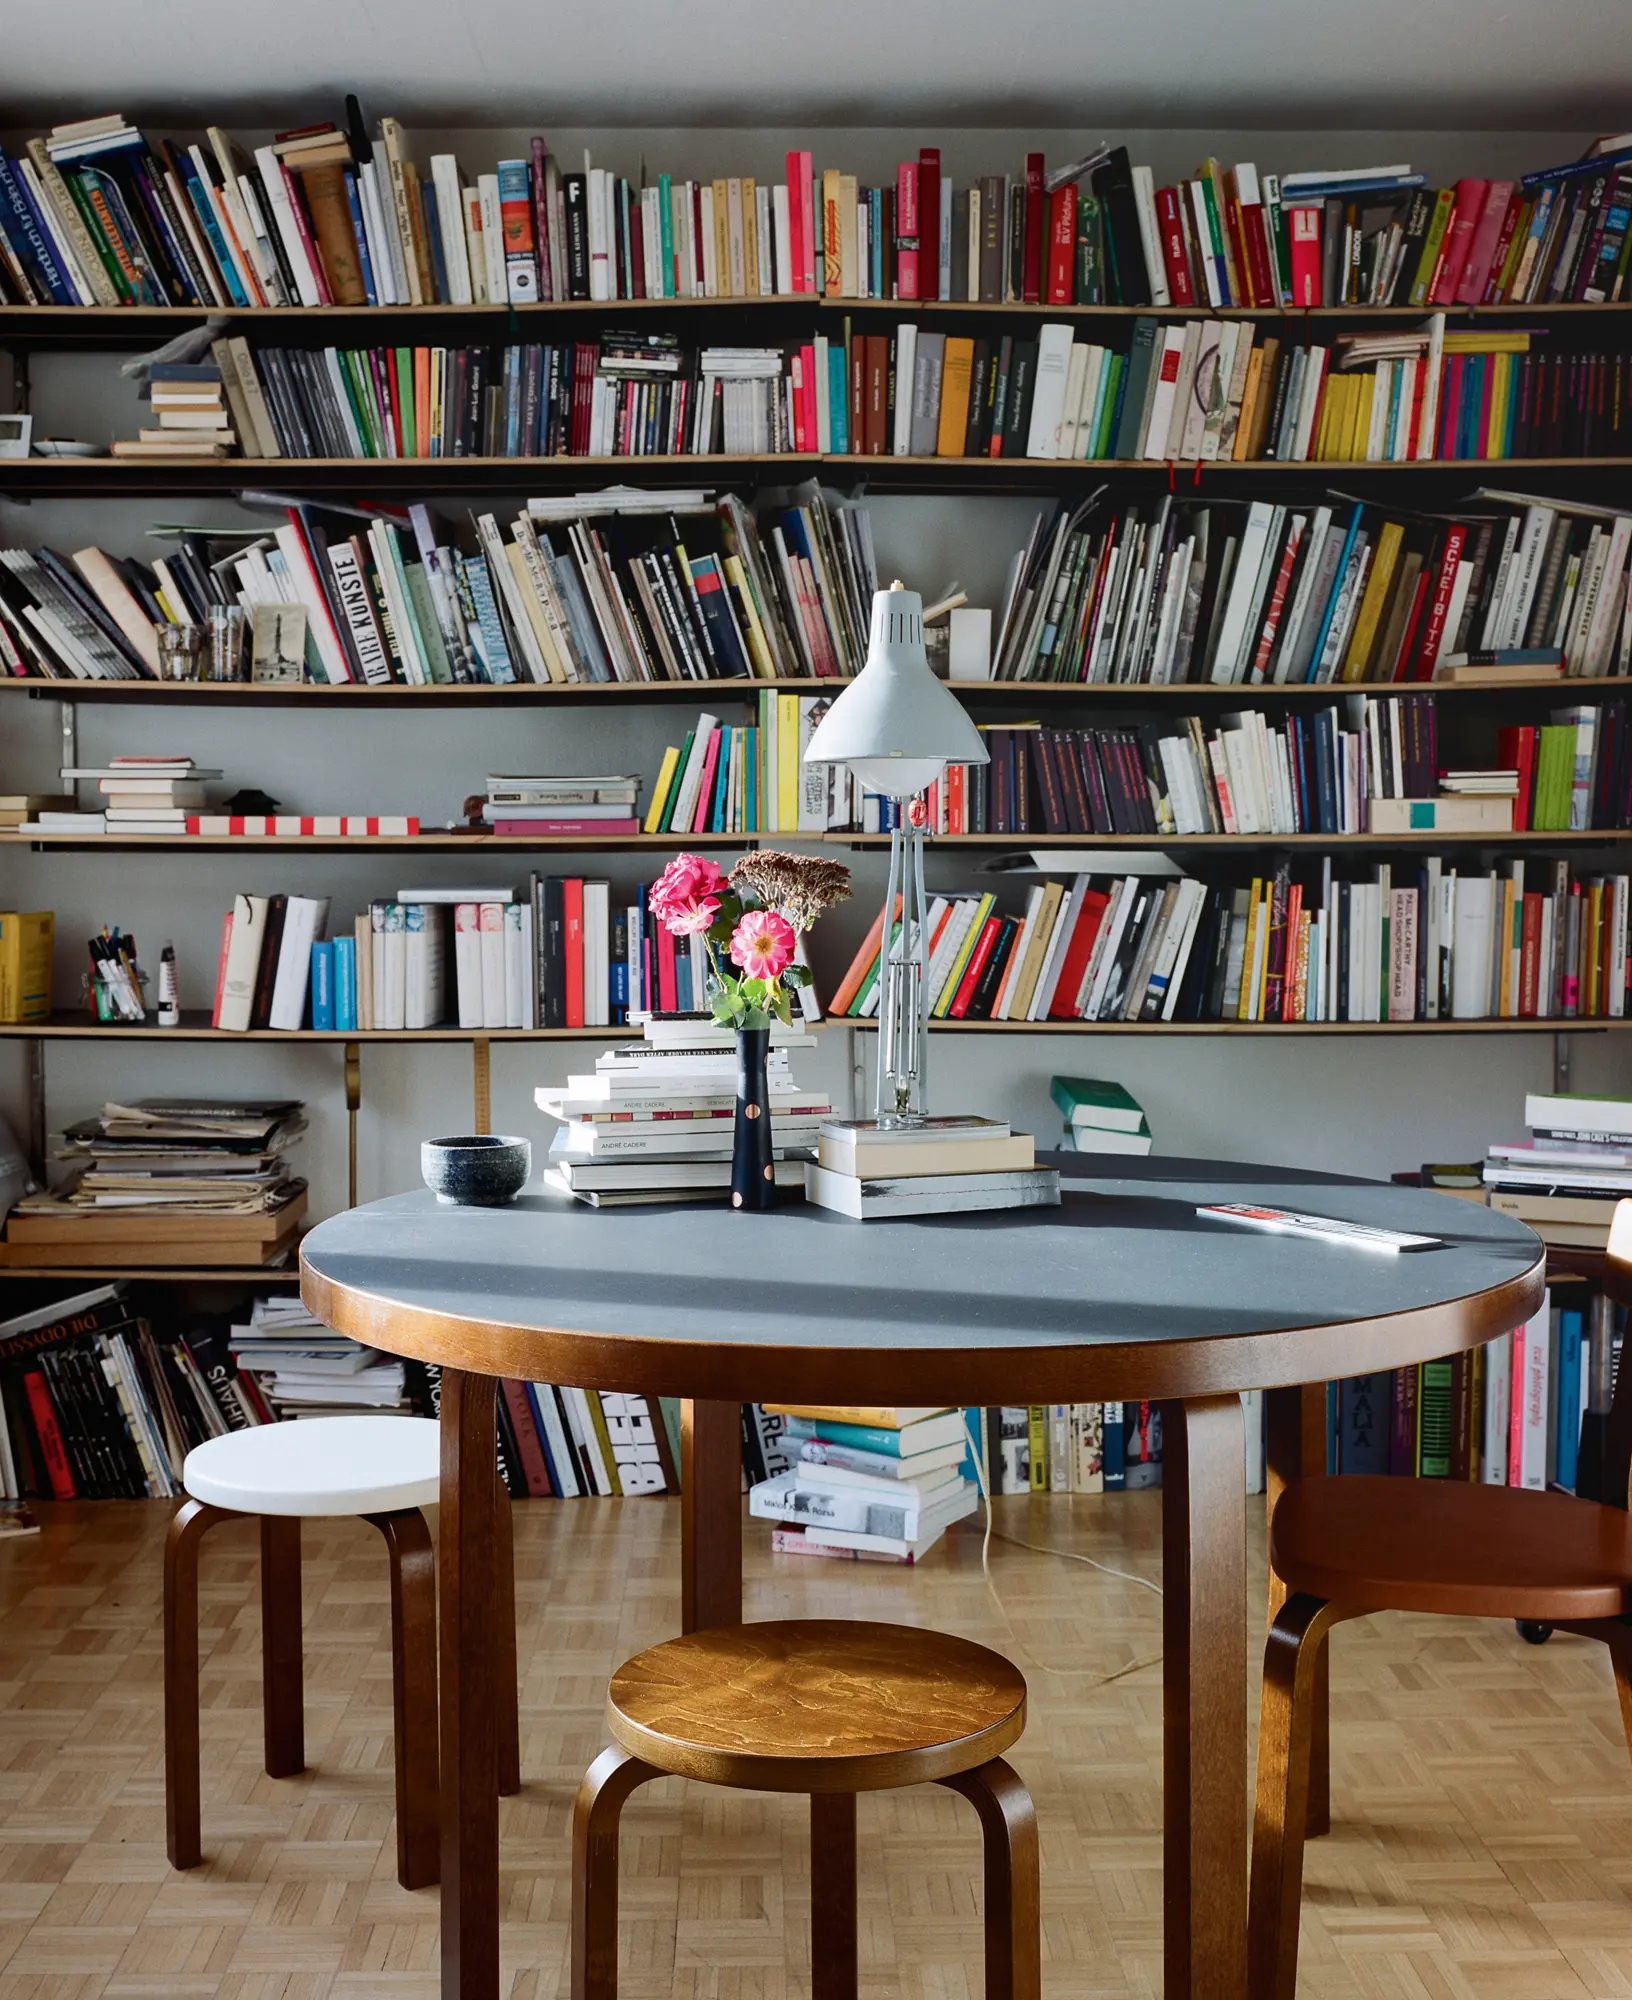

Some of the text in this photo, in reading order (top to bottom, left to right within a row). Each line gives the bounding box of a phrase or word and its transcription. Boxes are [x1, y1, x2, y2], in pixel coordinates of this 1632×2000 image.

[0, 159, 27, 214] Beleuch
[569, 182, 580, 202] F
[25, 226, 61, 289] Handbuch
[574, 252, 582, 277] DANIEL
[1351, 230, 1363, 266] LONDON
[1422, 534, 1461, 656] SCHEIBITZ
[1579, 564, 1601, 637] KIPPENBERGER
[1395, 893, 1403, 917] HEAD
[1402, 893, 1413, 965] PAUL McCARTHY
[1393, 972, 1402, 998] HEAD
[600, 1141, 621, 1149] ANDRÉ
[0, 1323, 68, 1358] ODYSSE
[206, 1365, 252, 1432] UHAUS
